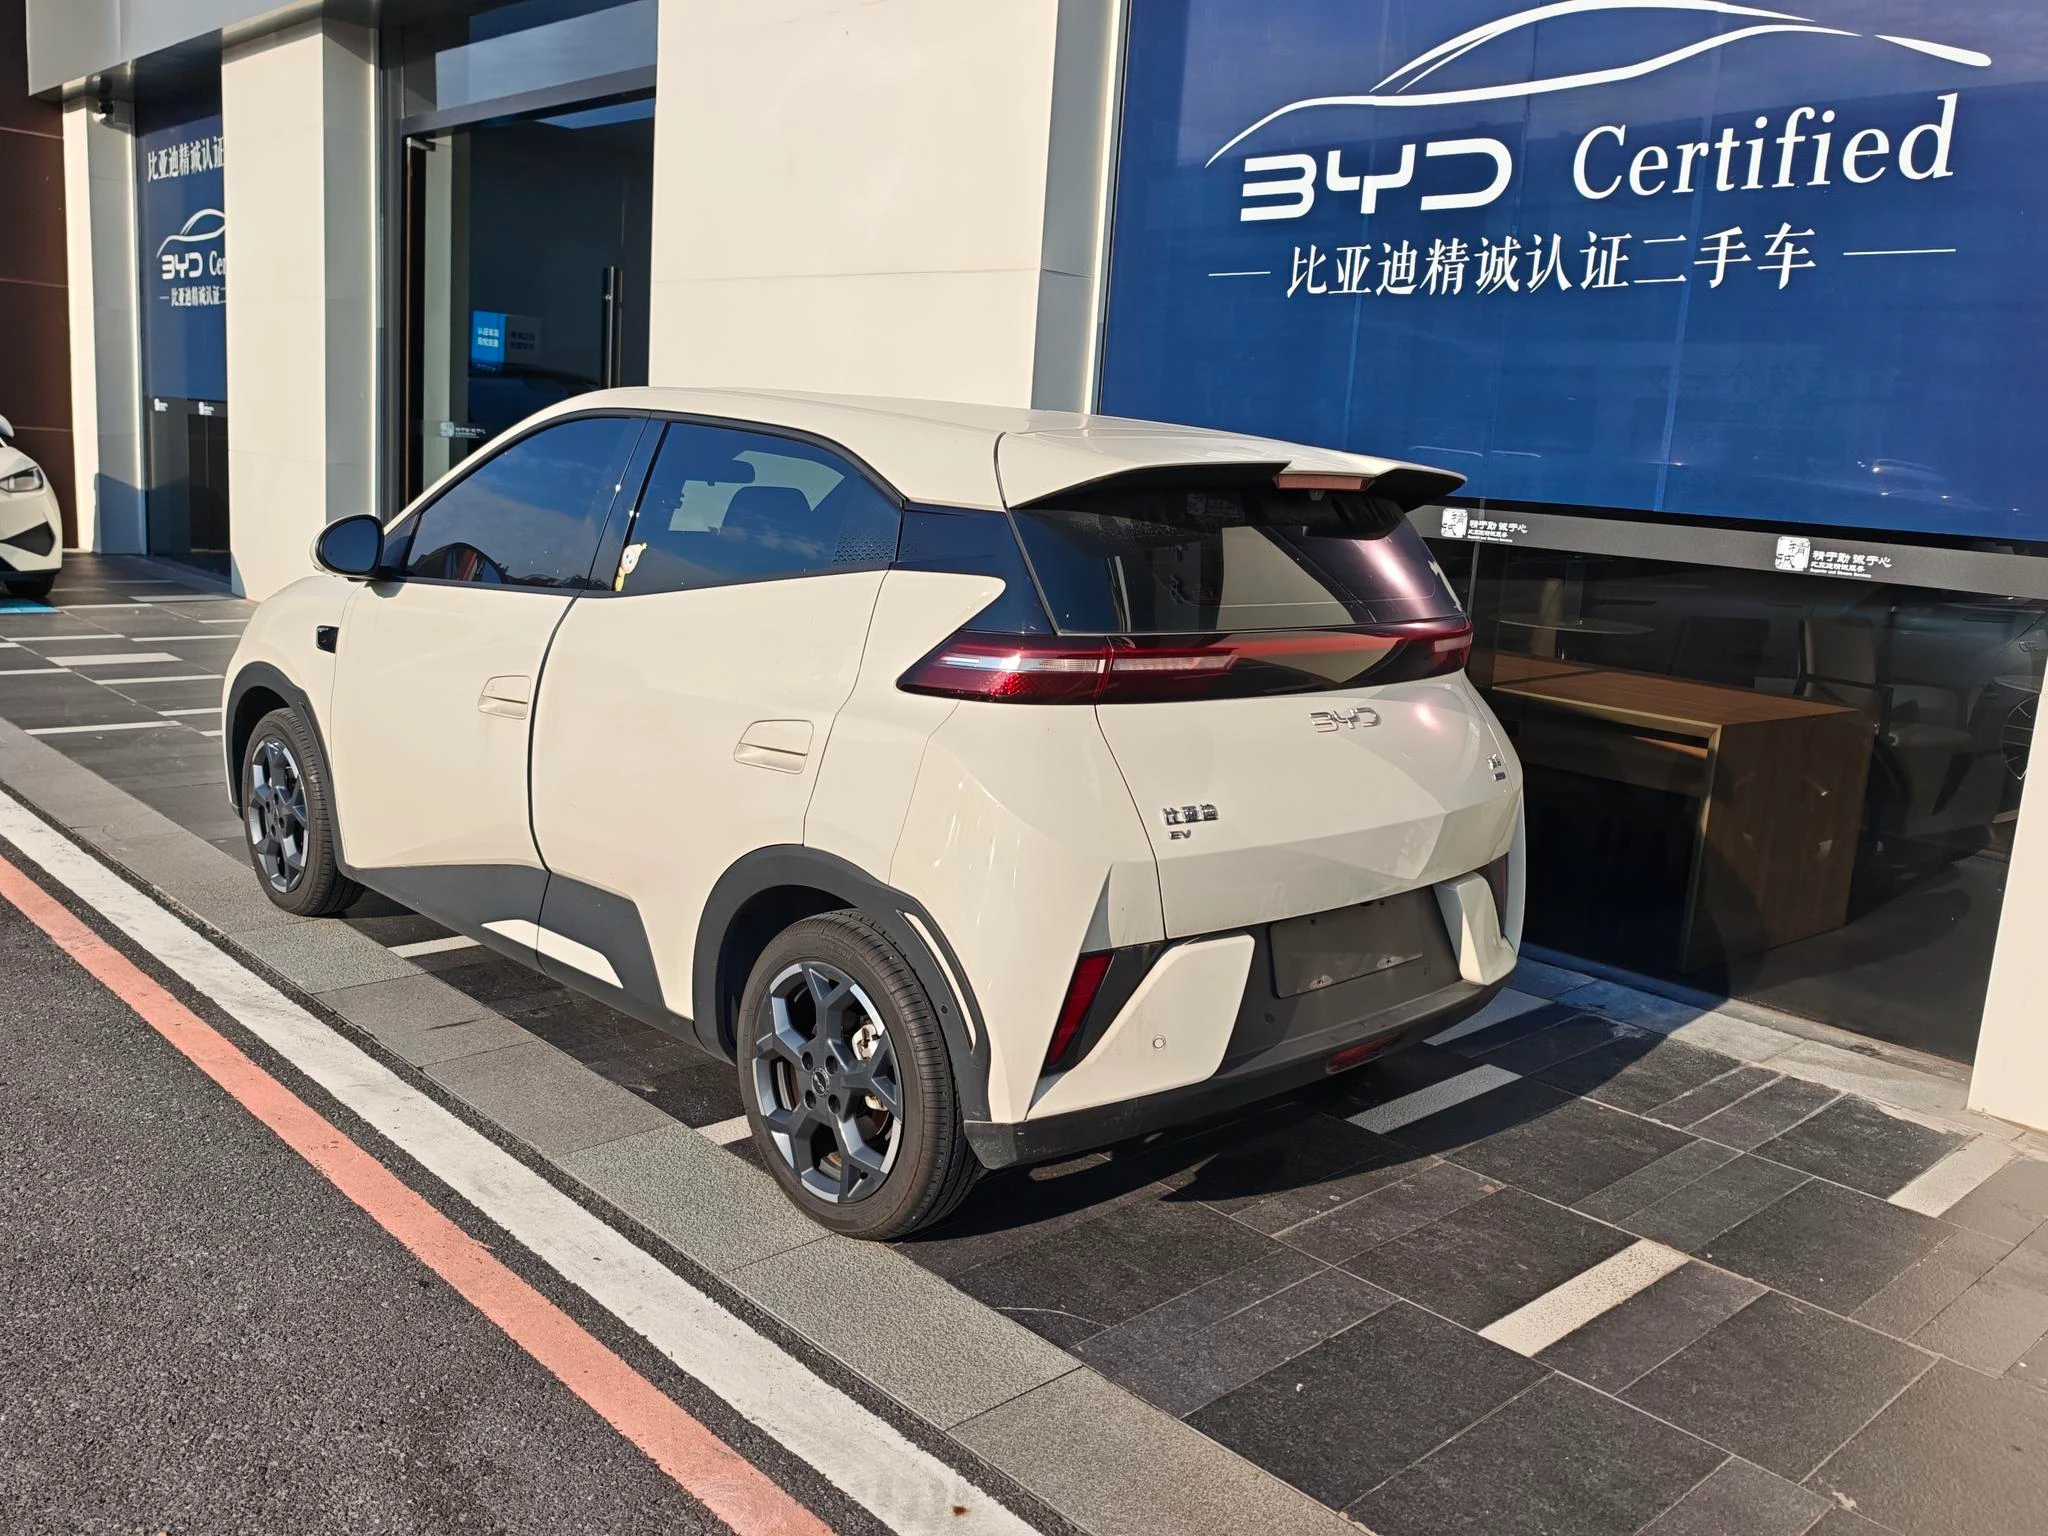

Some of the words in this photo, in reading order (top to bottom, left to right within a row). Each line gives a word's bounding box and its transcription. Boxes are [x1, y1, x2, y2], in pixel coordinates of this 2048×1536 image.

[1240, 137, 1513, 222] BYD
[1573, 93, 1958, 200] Certified
[162, 252, 203, 280] BYD
[1286, 222, 1816, 298] 比亚迪精诚认证二手车
[1308, 707, 1381, 733] BYD
[1169, 829, 1192, 840] EV
